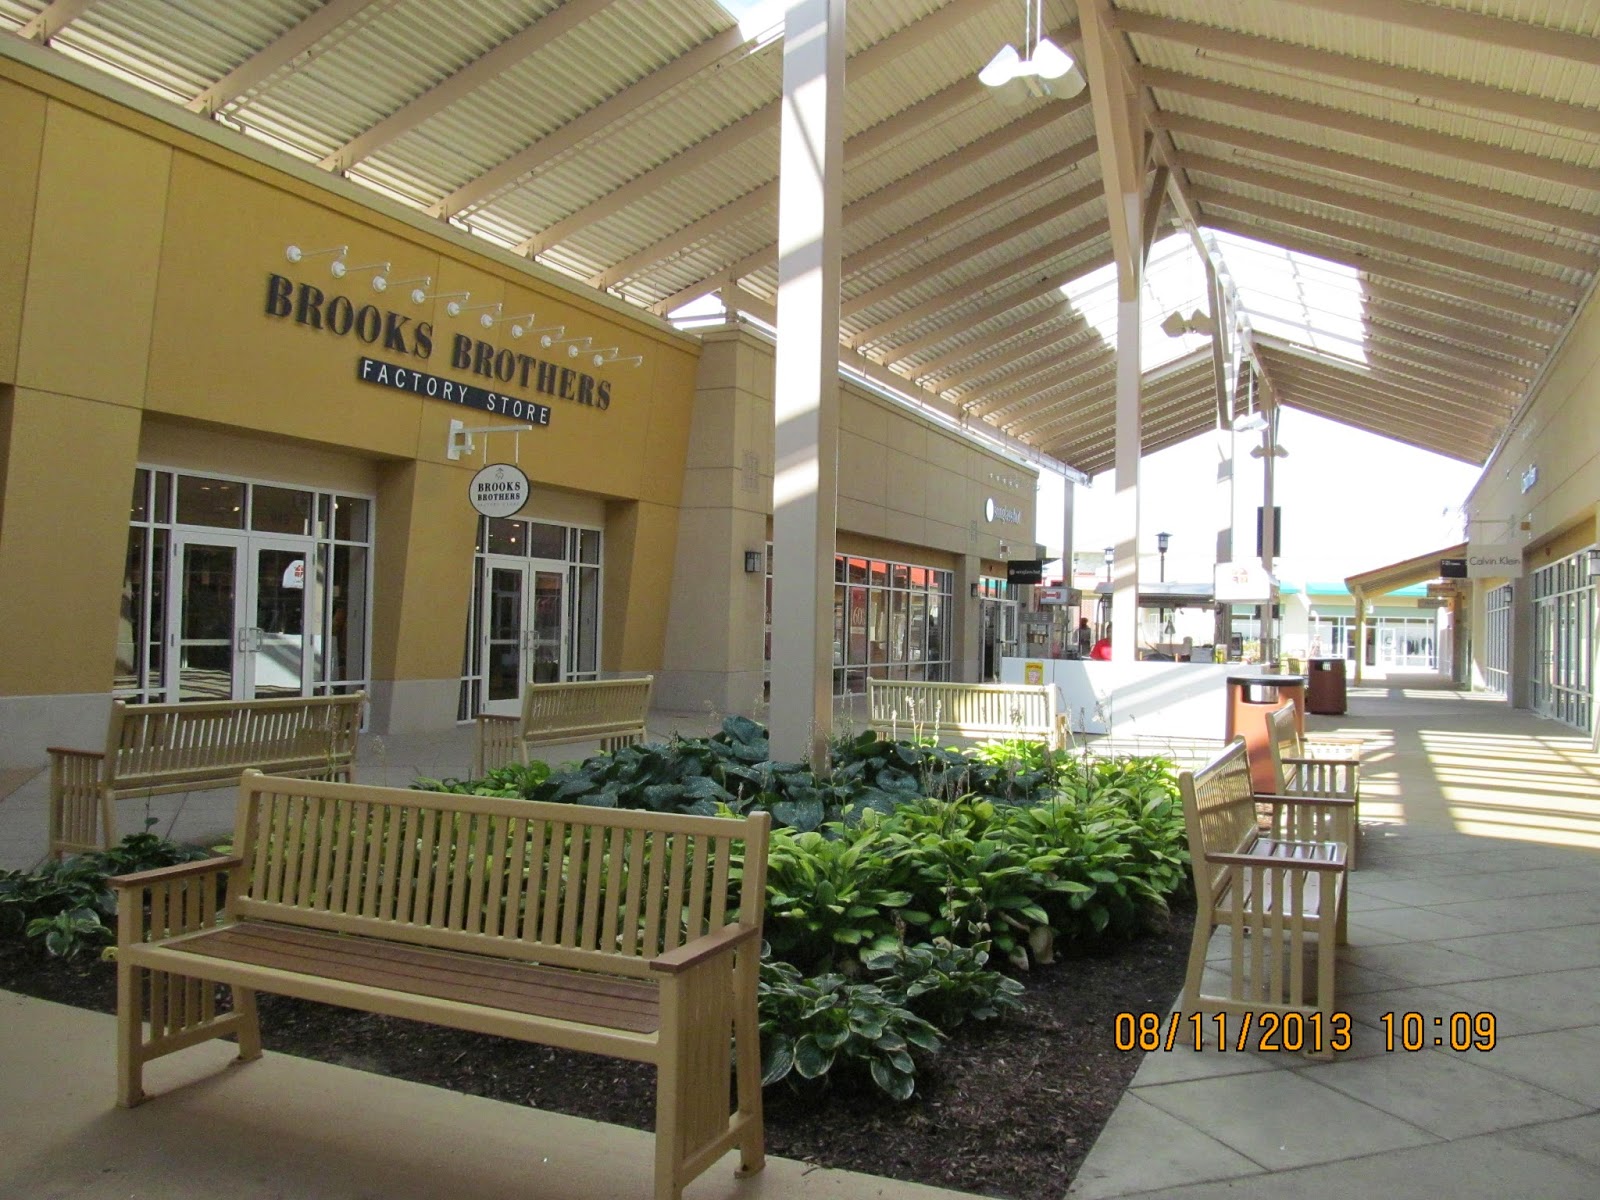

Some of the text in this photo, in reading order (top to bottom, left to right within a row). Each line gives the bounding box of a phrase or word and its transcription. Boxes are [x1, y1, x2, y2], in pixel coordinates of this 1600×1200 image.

[265, 273, 612, 412] BROOKS BROTHERS
[362, 360, 549, 425] FACTORY STORE
[478, 482, 520, 492] BROOKS
[478, 493, 520, 501] BROTHERS
[1469, 556, 1497, 566] Calvin
[1499, 556, 1521, 566] Klein
